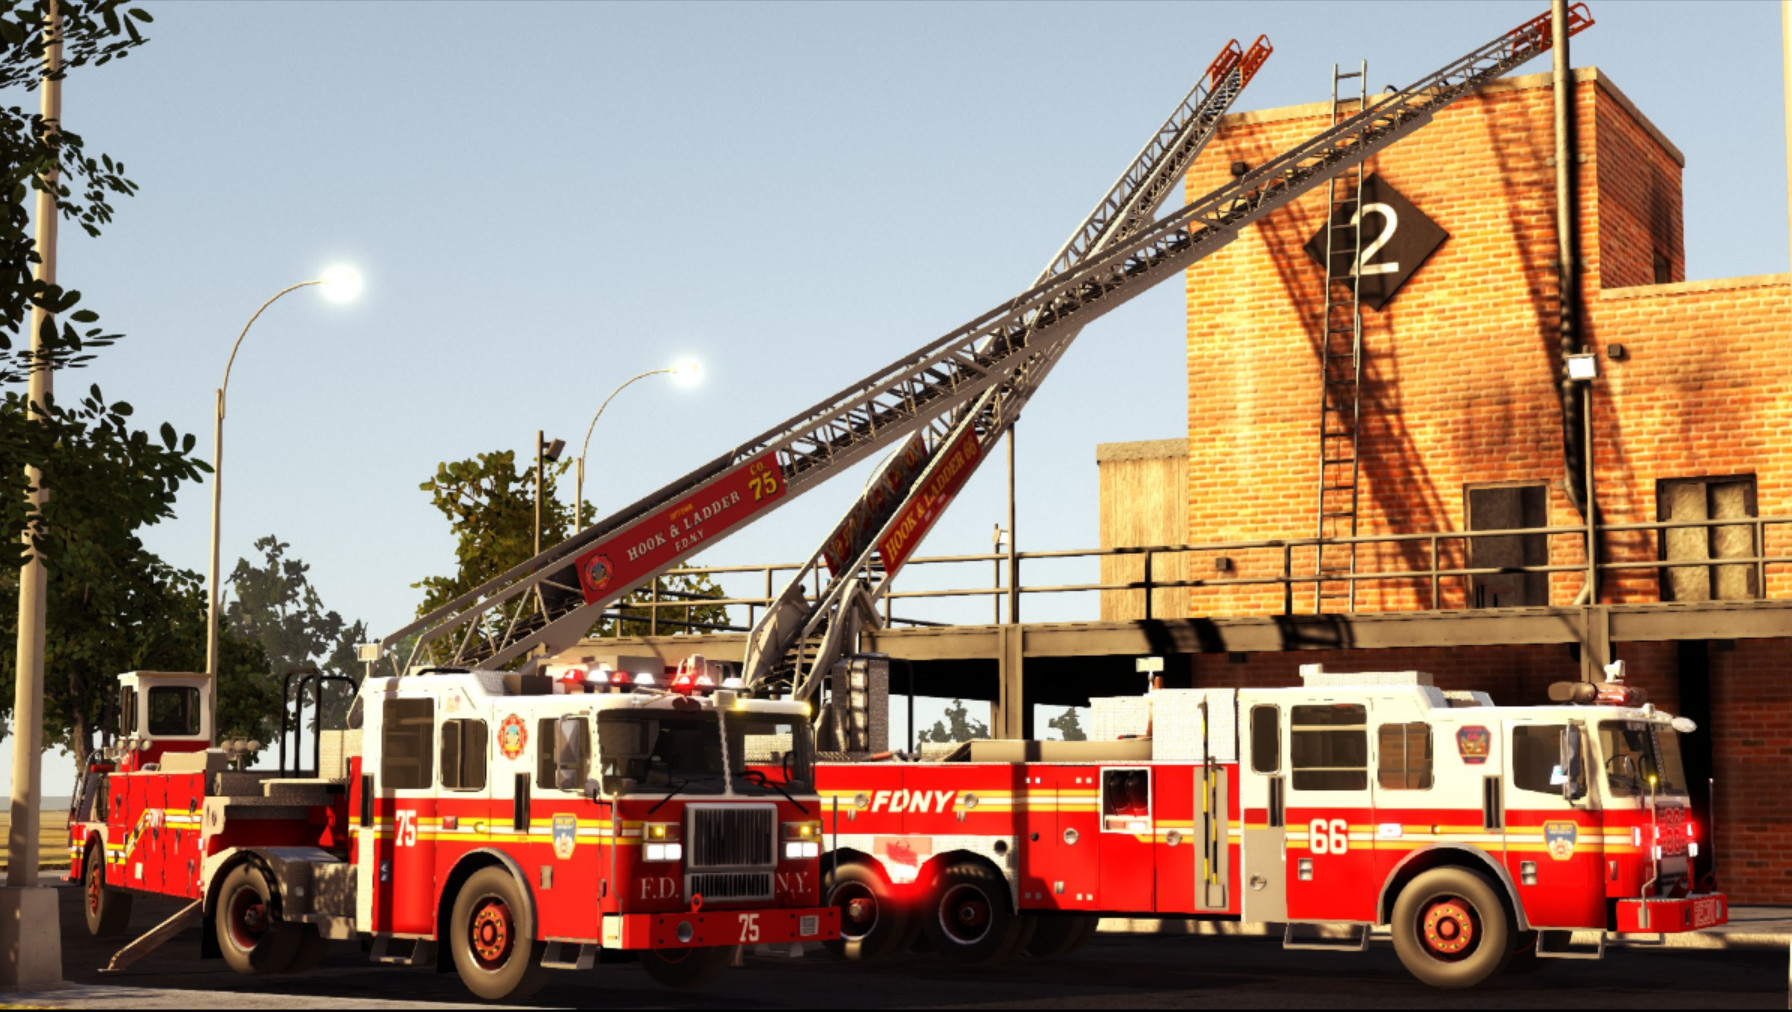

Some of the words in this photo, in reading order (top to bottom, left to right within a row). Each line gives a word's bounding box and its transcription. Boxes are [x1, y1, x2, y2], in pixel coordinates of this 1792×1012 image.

[1349, 202, 1400, 276] 2
[749, 461, 767, 475] CO.
[748, 470, 779, 502] 75
[884, 514, 918, 564] HOOK
[916, 502, 925, 518] &
[923, 452, 966, 507] LADDER
[626, 529, 668, 562] HOOK
[669, 523, 681, 538] &
[682, 490, 741, 530] LADDER
[870, 788, 957, 814] FDNY
[394, 809, 418, 847] 75
[1309, 818, 1348, 855] 66
[640, 876, 680, 900] F.D.
[775, 870, 812, 894] N.Y.
[738, 913, 760, 942] 75
